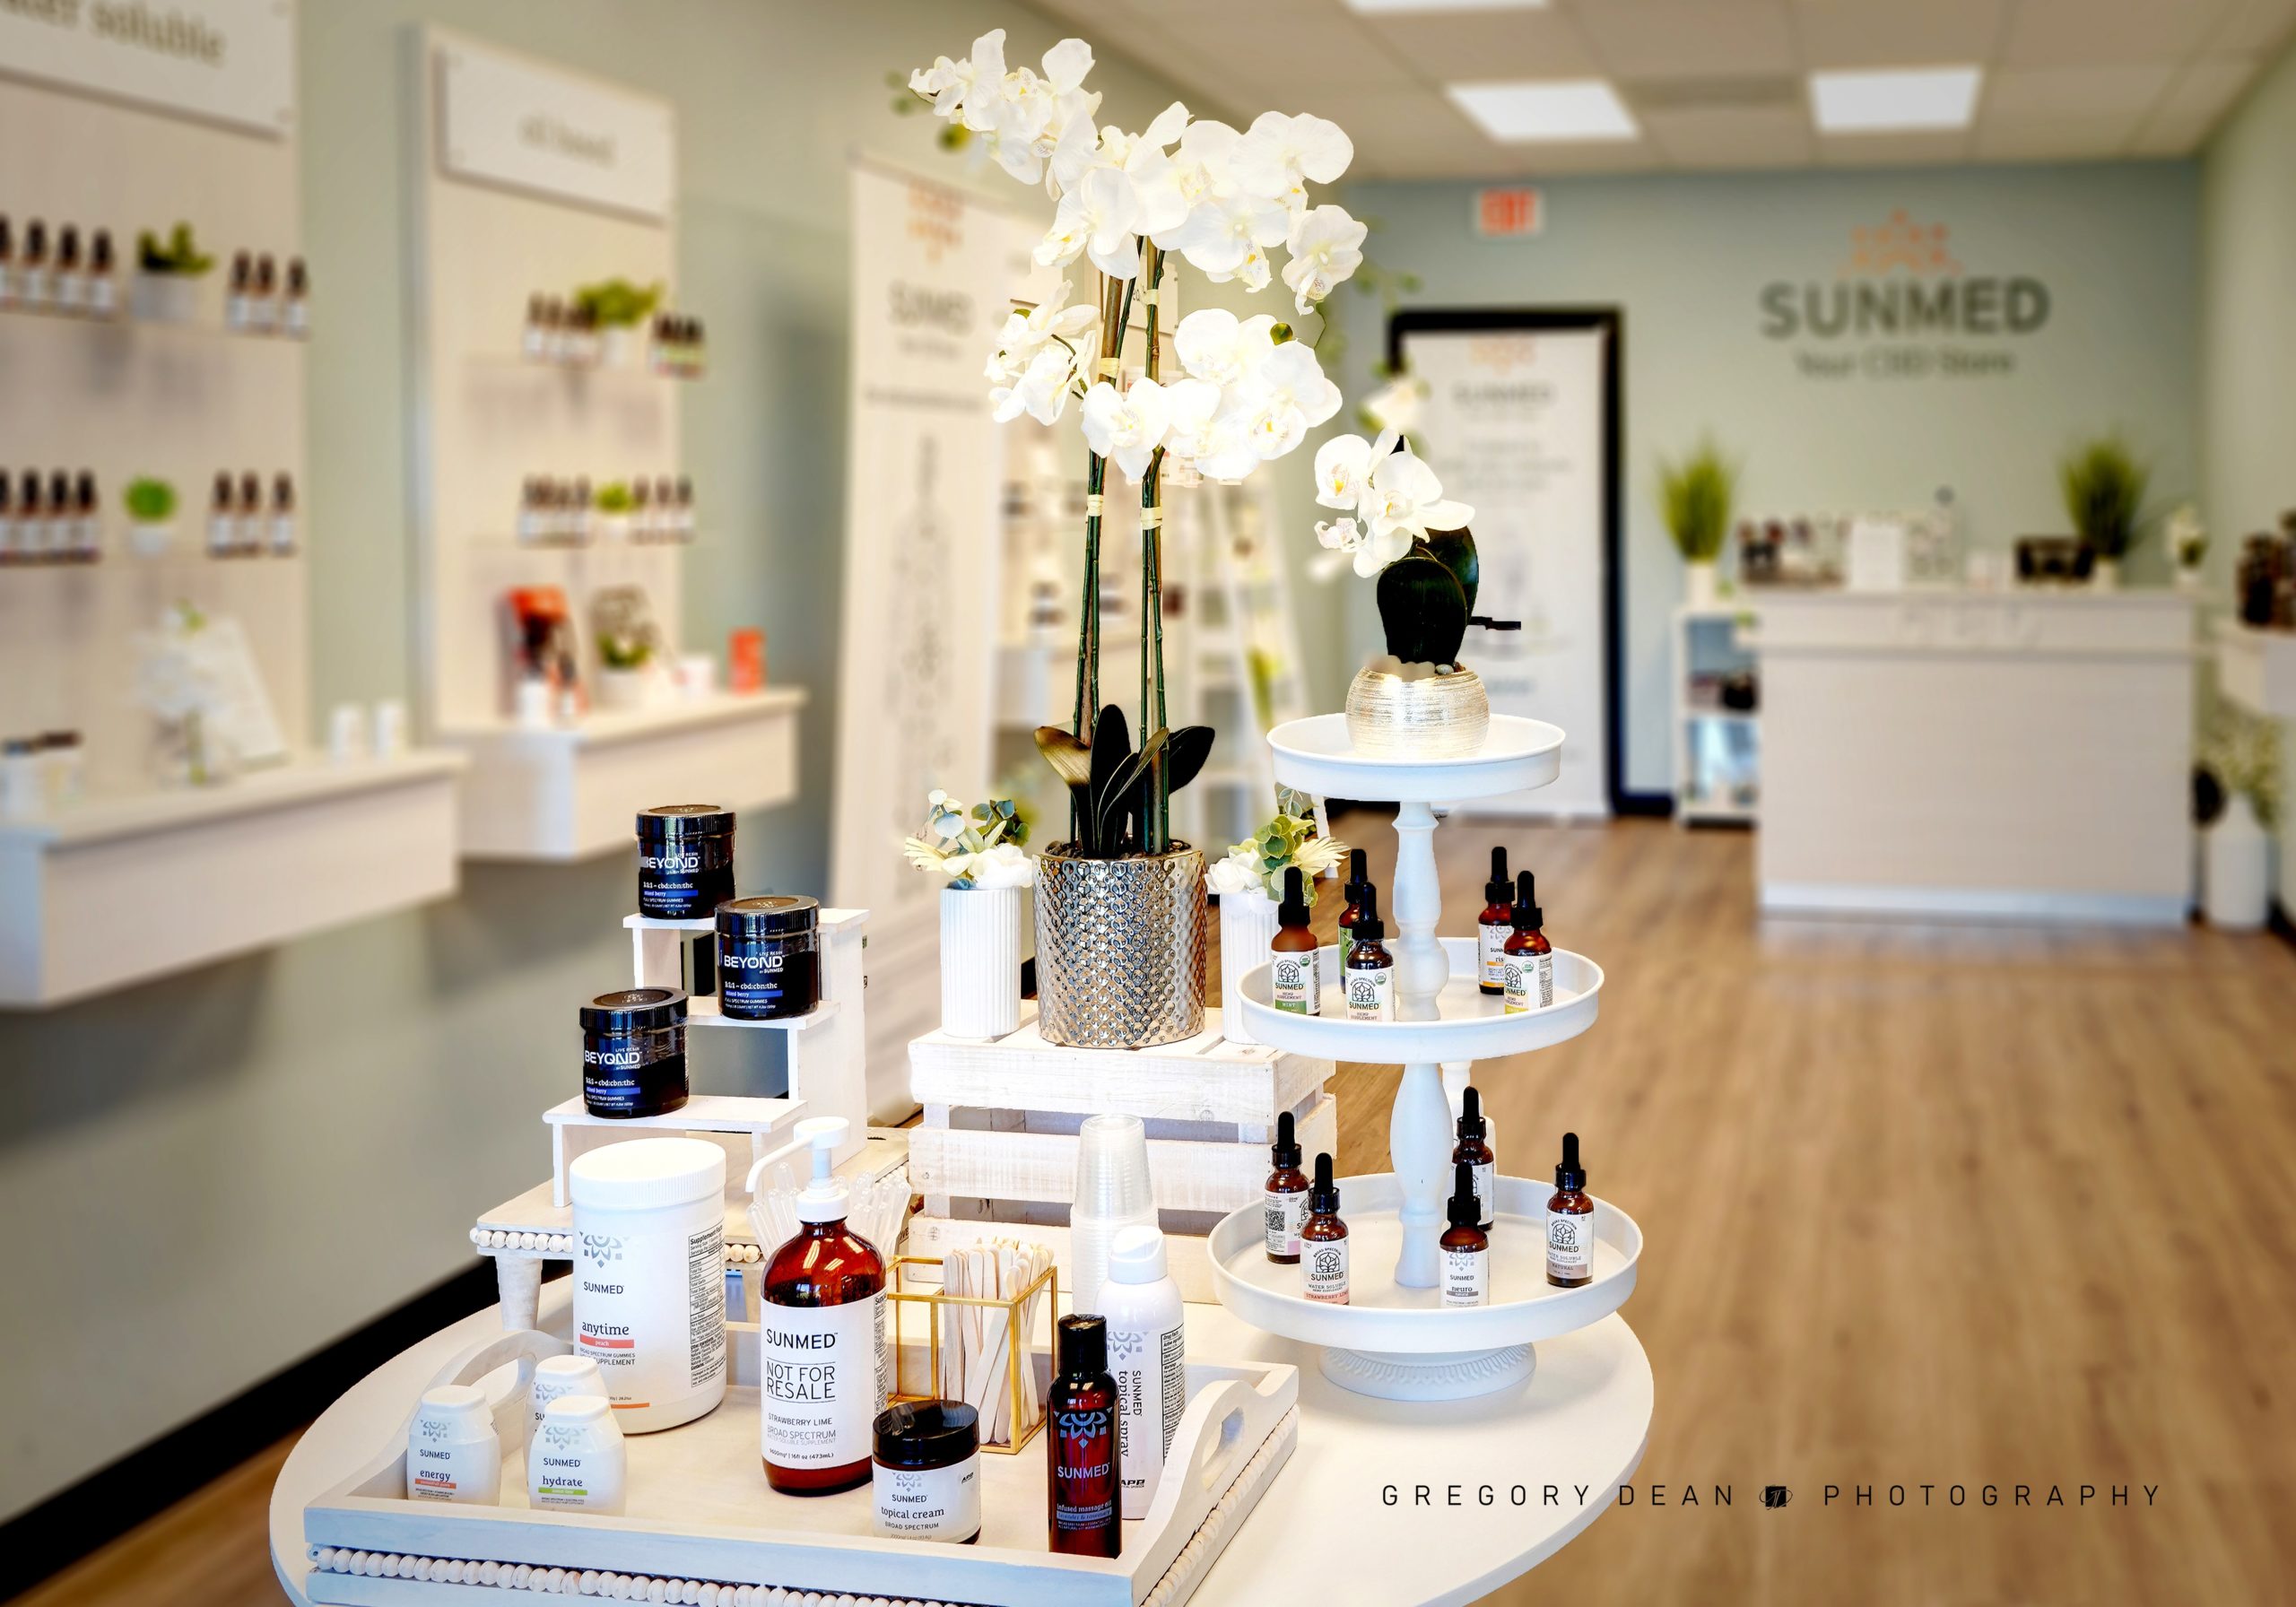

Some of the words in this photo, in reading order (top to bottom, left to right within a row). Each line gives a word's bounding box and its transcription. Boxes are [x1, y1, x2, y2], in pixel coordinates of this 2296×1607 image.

[1758, 276, 2052, 341] SUNMED
[724, 955, 783, 969] BEYOND
[1275, 982, 1304, 990] SUNMED
[1506, 988, 1526, 996] NMED
[1349, 1002, 1379, 1010] SUNMED
[585, 1050, 640, 1064] BEYOND
[1313, 1247, 1325, 1257] BROAD
[1325, 1247, 1342, 1256] SPECTRUM
[1549, 1241, 1579, 1253] SUNMED
[1310, 1272, 1344, 1281] SUNMED
[583, 1281, 624, 1294] SUNMED
[1306, 1292, 1338, 1300] STRAWBERRY
[582, 1322, 630, 1336] anytime
[595, 1340, 610, 1348] peach
[767, 1328, 836, 1349] SUNMED
[767, 1360, 793, 1380] NOT
[799, 1366, 835, 1382] FOR
[767, 1377, 835, 1400] RESALE
[1118, 1370, 1130, 1417] topical
[1132, 1370, 1142, 1416] SUNMED
[769, 1413, 811, 1426] STRAWBERRY
[813, 1418, 832, 1426] LIME
[768, 1425, 788, 1438] BROAD
[789, 1429, 836, 1440] SPECTRUM
[420, 1448, 451, 1460] SUNMED
[544, 1457, 581, 1467] SUNMED
[420, 1470, 451, 1482] energy
[1057, 1464, 1109, 1479] SUNMED
[543, 1475, 583, 1487] hydrate
[891, 1494, 927, 1503] SUNMED
[881, 1507, 909, 1519] topical
[912, 1508, 944, 1519] cream
[1078, 1502, 1103, 1513] massage
[884, 1521, 902, 1530] BROAD
[905, 1523, 939, 1531] SPECTRUM
